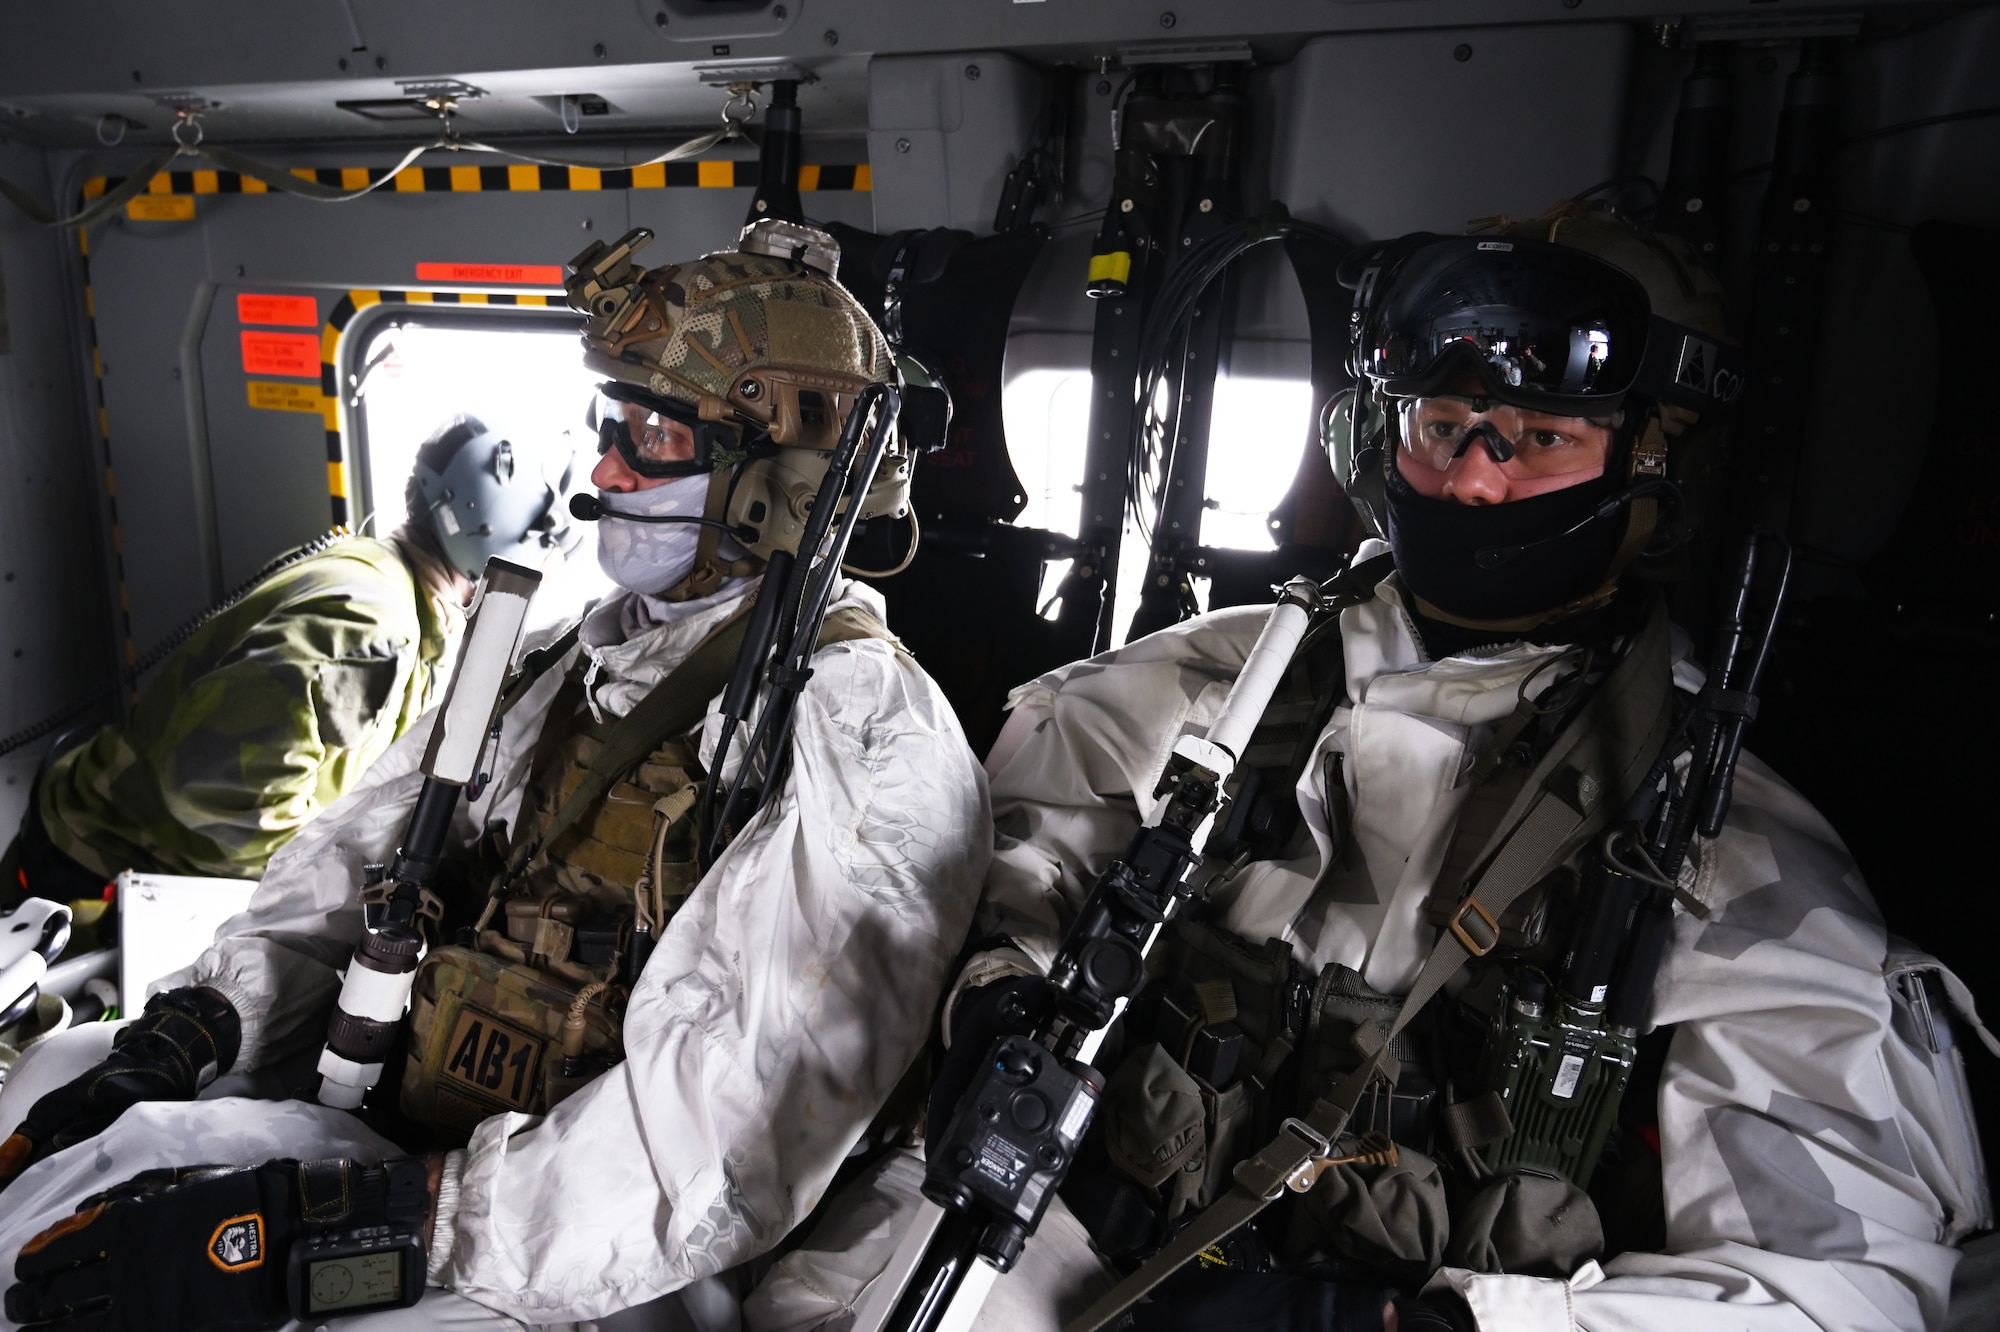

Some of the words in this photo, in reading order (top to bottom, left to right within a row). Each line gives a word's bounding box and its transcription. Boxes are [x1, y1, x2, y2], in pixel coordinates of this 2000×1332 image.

[453, 267, 502, 280] EMERGENCY
[505, 268, 522, 281] EXIT
[448, 1020, 532, 1101] AB1
[980, 1156, 1006, 1176] DANGER
[248, 1222, 258, 1257] HESTRA
